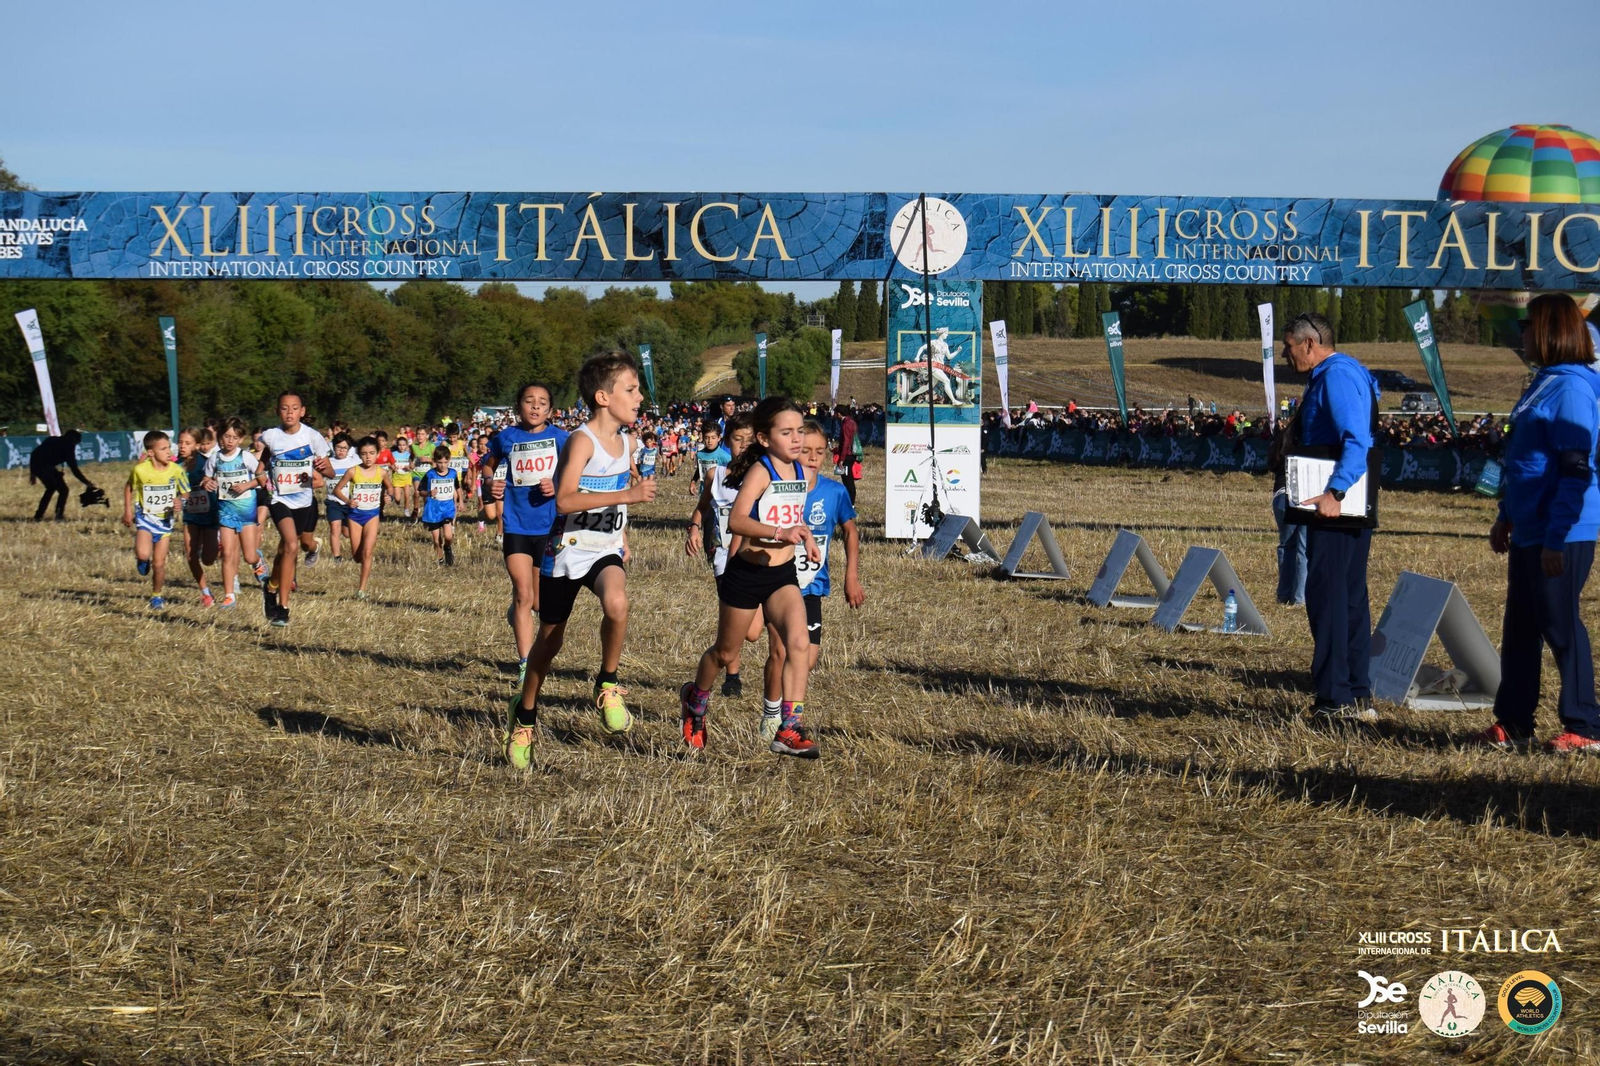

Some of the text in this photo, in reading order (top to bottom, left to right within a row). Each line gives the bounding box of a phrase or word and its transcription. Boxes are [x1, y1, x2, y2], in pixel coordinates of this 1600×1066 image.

[0, 216, 88, 232] ANDALUCÍA
[149, 204, 309, 257] XLIII
[312, 205, 436, 237] CROSS
[493, 191, 795, 263] ITÁLICA
[1174, 208, 1300, 242] CROSS
[1012, 205, 1169, 260] XLIII
[1355, 199, 1600, 273] ITÁLIC
[312, 238, 482, 257] INTERNACIONAL
[1174, 242, 1343, 262] INTERNACIONAL
[149, 260, 452, 277] INTERNATIONAL CROSS COUNTRY
[1010, 261, 1313, 283] INTERNATIONAL CROSS COUNTRY
[936, 297, 970, 307] Sevilla
[515, 455, 554, 474] 4407
[221, 480, 247, 491] 42
[276, 471, 309, 484] 4418
[146, 493, 174, 505] 4293
[356, 492, 380, 503] 4362
[573, 511, 623, 533] 4230
